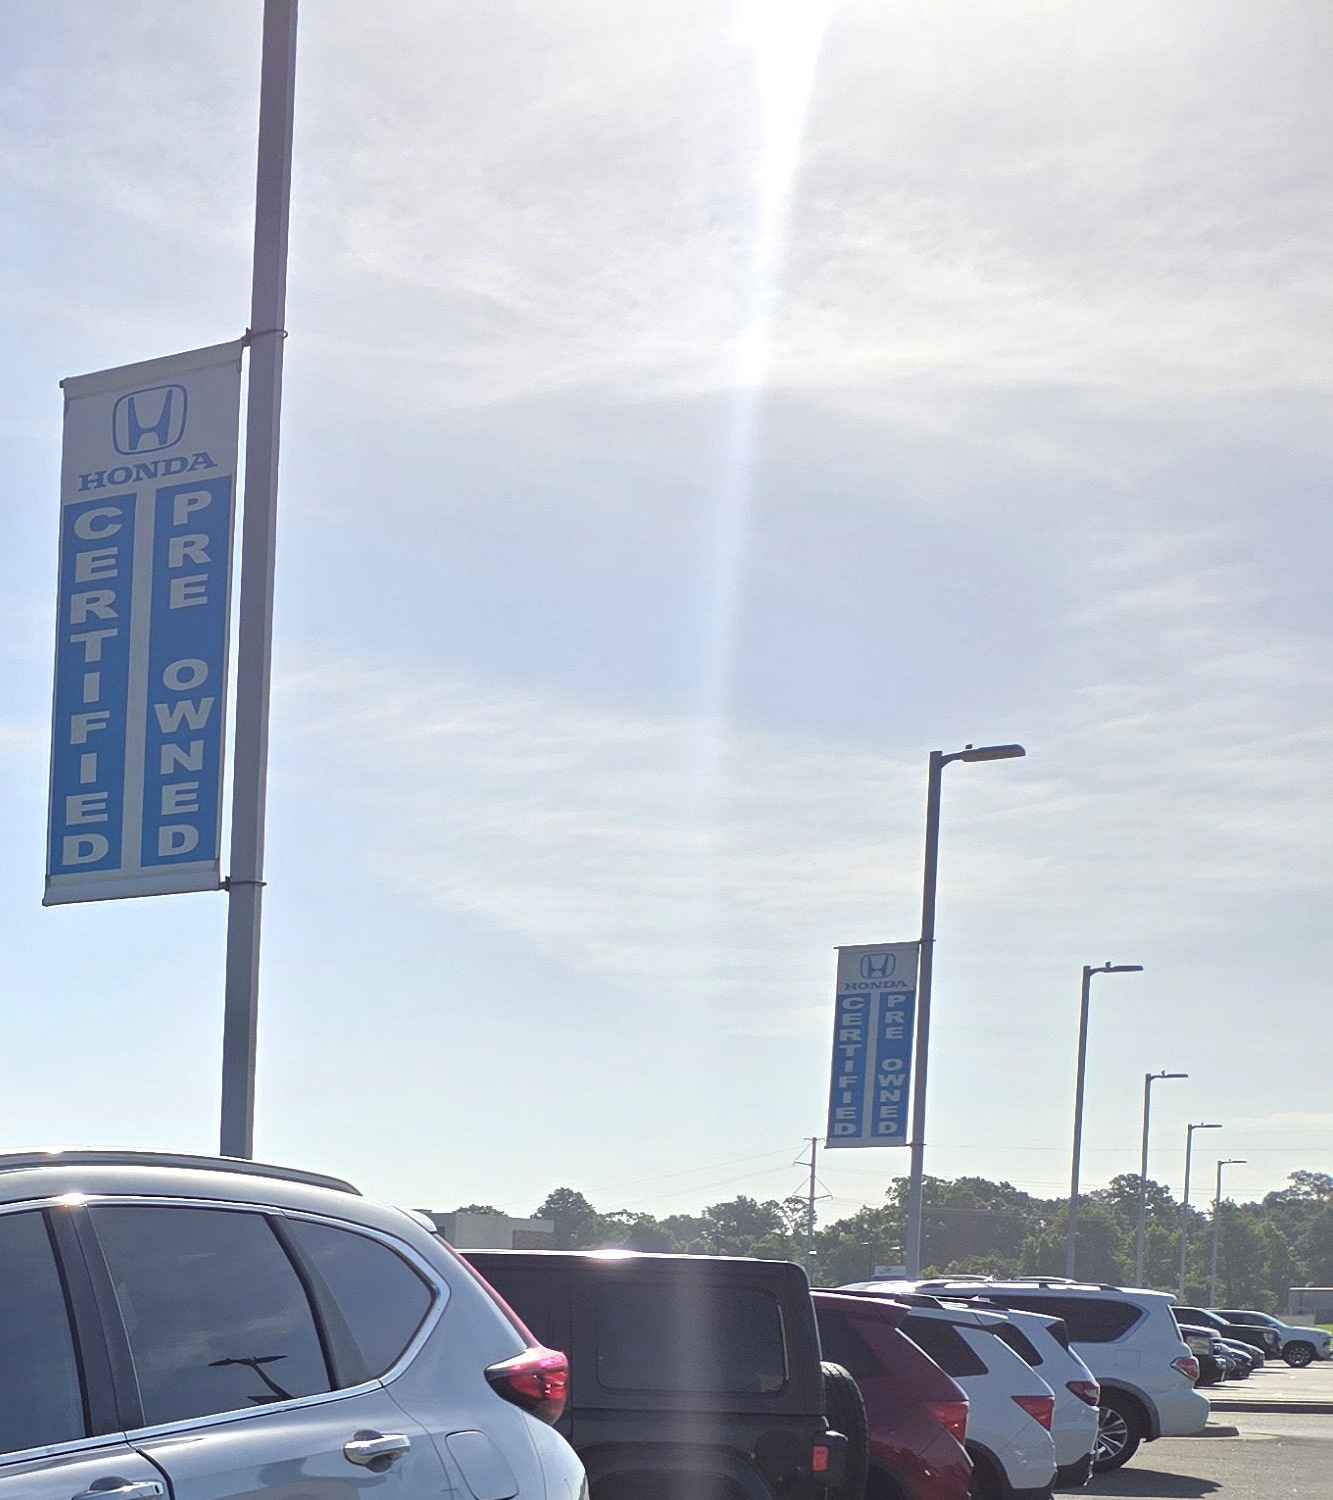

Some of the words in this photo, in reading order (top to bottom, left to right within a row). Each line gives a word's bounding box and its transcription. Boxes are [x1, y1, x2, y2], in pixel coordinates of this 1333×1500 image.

[78, 451, 217, 492] HONDA
[168, 490, 213, 609] PRE
[62, 506, 124, 866] CERTIFIED
[154, 658, 215, 857] OWNED
[844, 980, 908, 991] HONDA
[885, 994, 907, 1040] PRE
[834, 996, 865, 1136] CERTIFIED
[877, 1058, 906, 1135] OWNED
